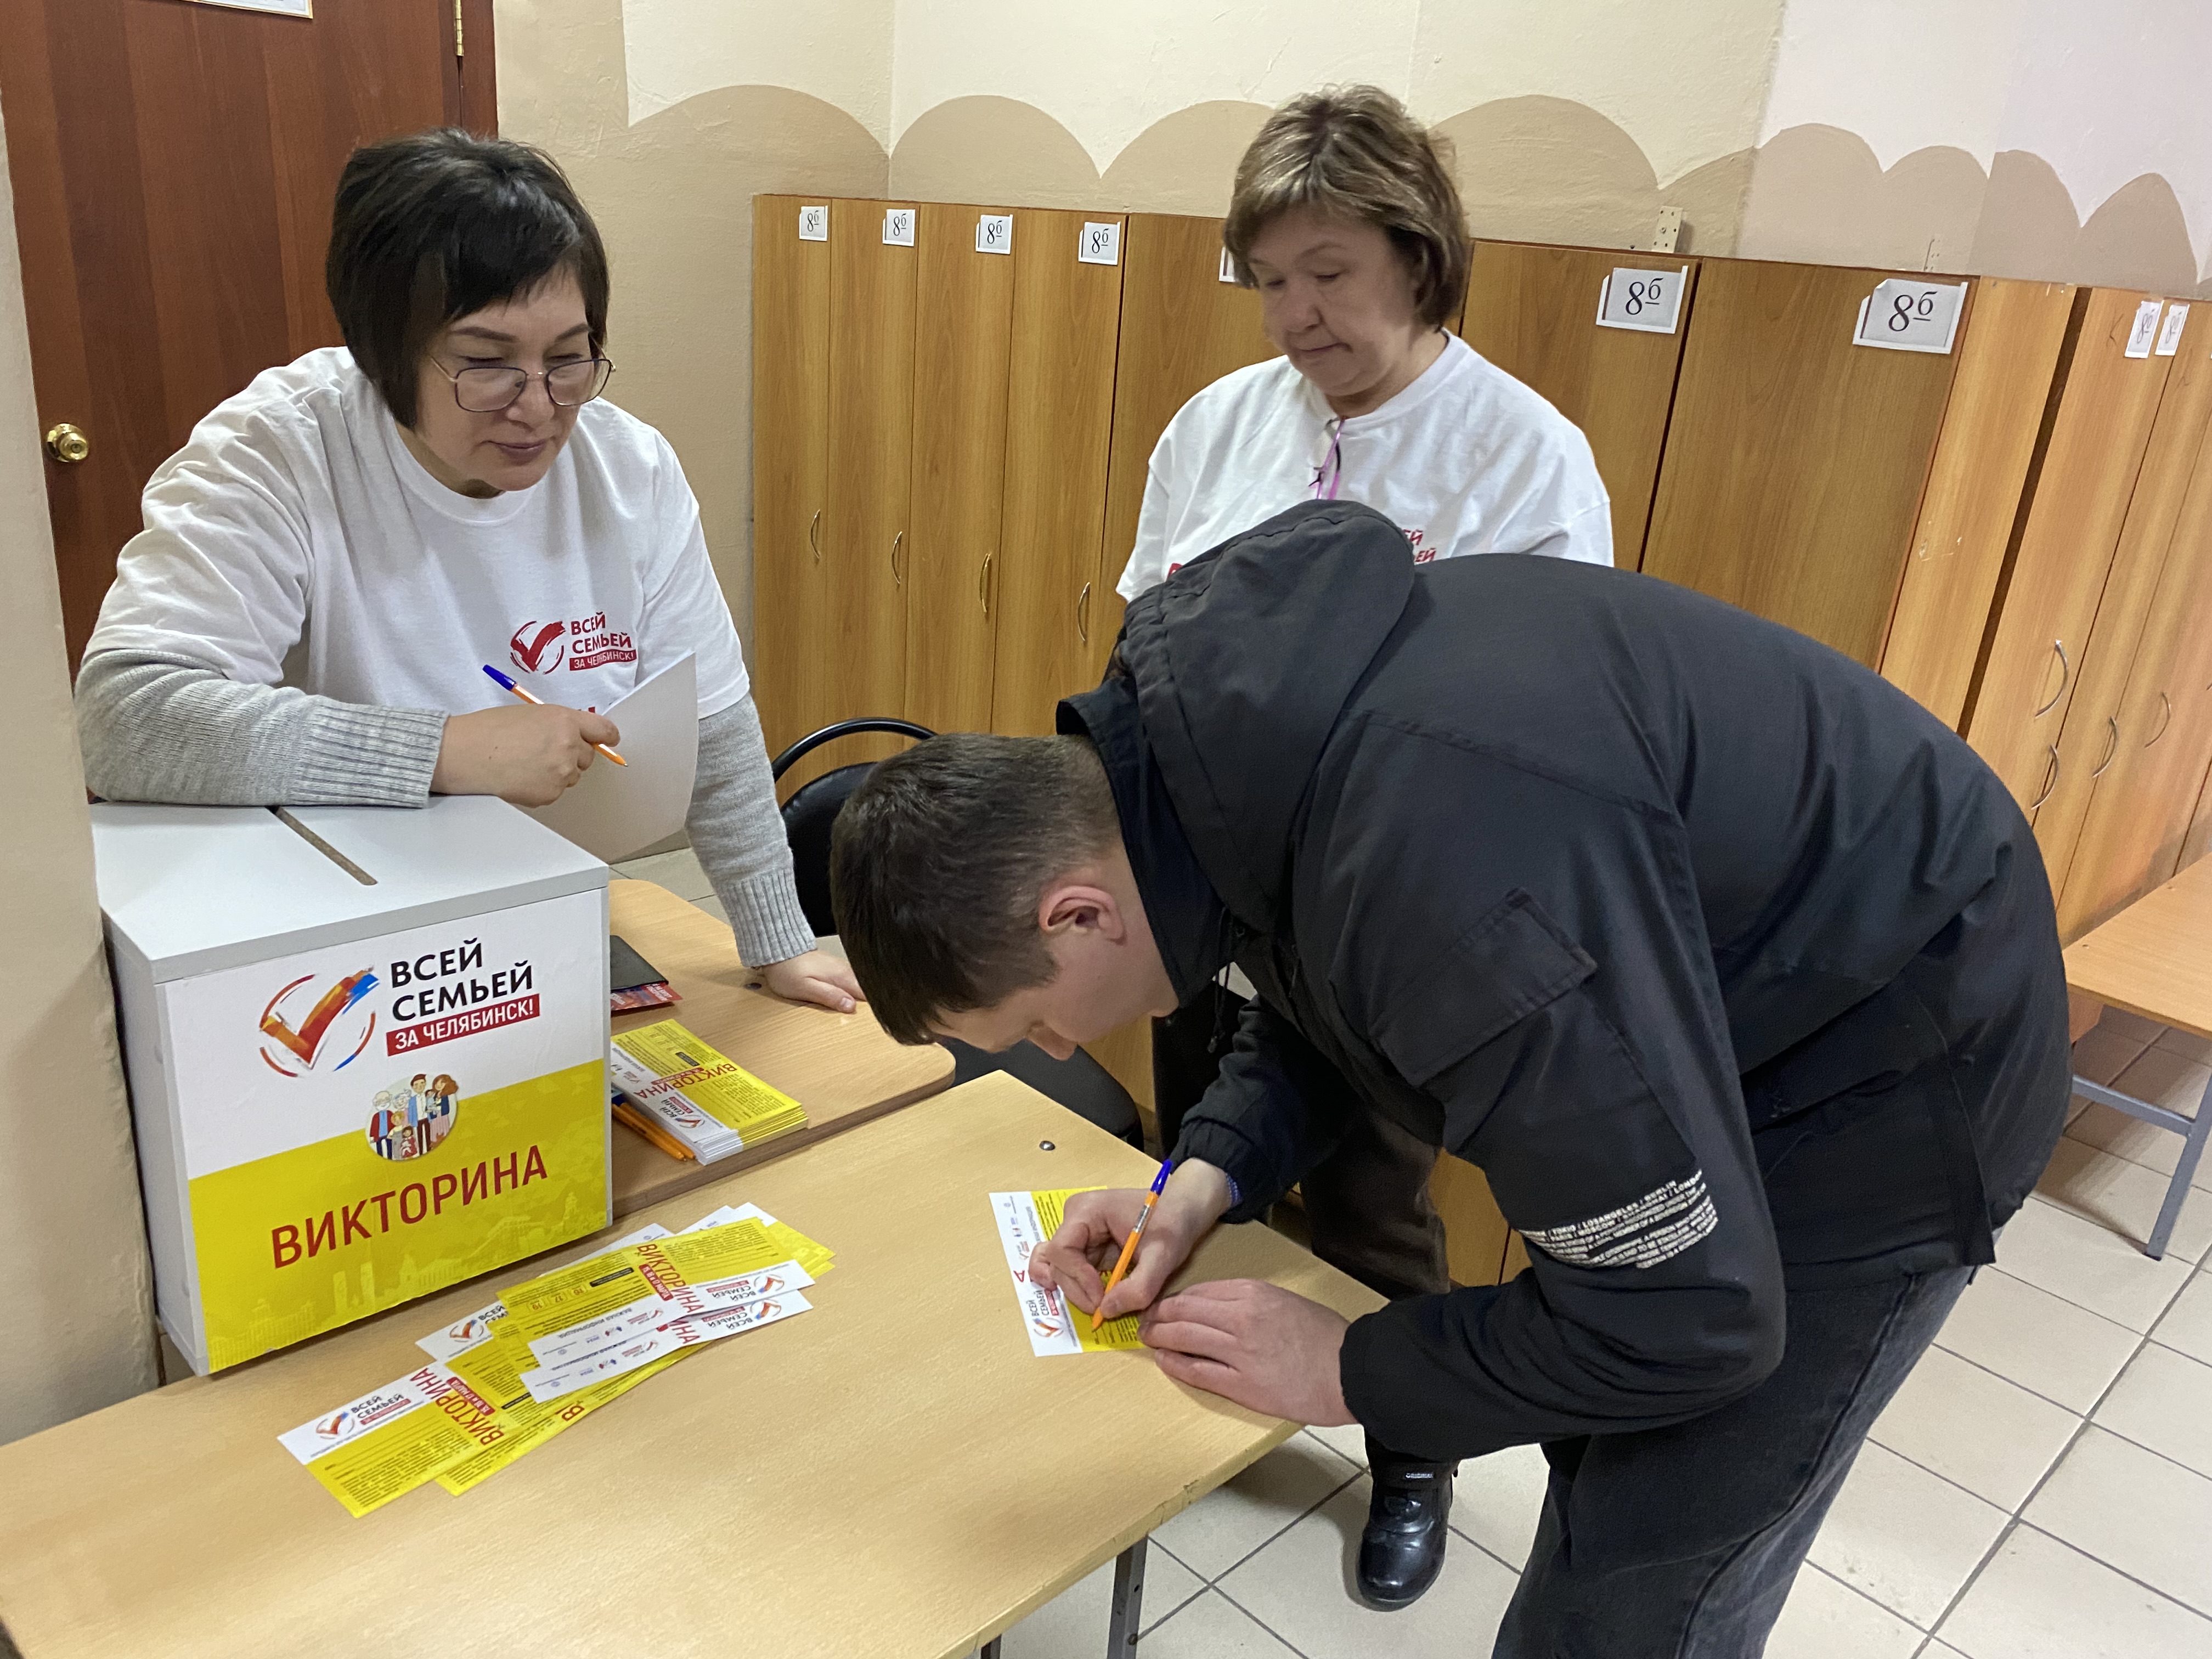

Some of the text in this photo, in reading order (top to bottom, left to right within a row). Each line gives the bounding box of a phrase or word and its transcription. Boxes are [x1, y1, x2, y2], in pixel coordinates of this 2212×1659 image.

[1625, 277, 1664, 315] 8б
[1888, 291, 1938, 332] 8б
[571, 611, 606, 635] ВСЕЙ
[572, 631, 632, 654] СЕМЬЕЙ
[574, 659, 585, 669] ЗА
[390, 937, 483, 989] ВСЕЙ
[392, 960, 533, 1022] СЕМЬЕЙ
[394, 1000, 534, 1050] ЗА ЧЕЛЯБИНСК!
[634, 1063, 737, 1099] ВИКТОРИНА
[272, 1144, 548, 1268] ВИКТОРИНА
[637, 1244, 705, 1313] ВИКТОРИНА
[730, 1290, 757, 1301] ВСЕЙ
[708, 1312, 748, 1328] СЕМЬЕЙ
[726, 1317, 753, 1329] ВСЕЙ
[410, 1367, 504, 1446] ВИКТОРИНА
